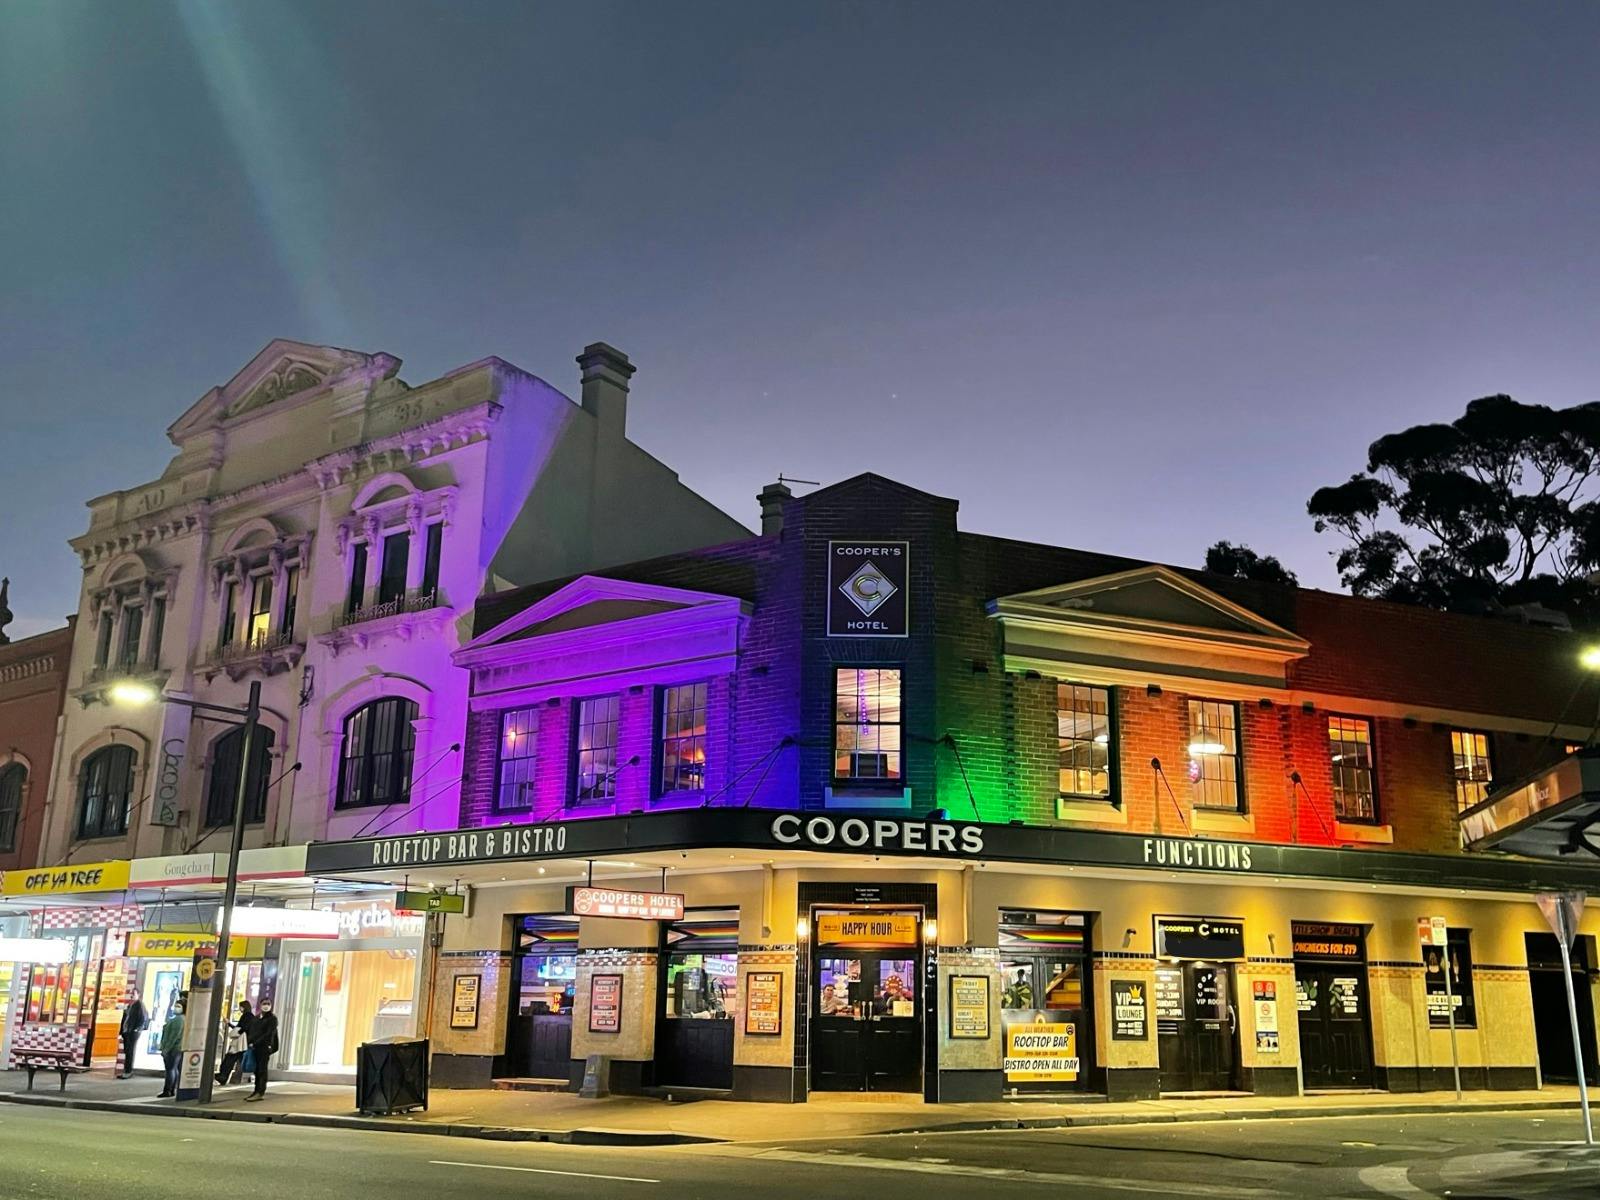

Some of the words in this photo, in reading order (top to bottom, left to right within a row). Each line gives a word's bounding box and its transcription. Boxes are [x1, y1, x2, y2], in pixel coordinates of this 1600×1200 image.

[836, 547, 902, 556] COOPER'S
[851, 574, 882, 602] C
[847, 621, 888, 630] HOTEL
[771, 813, 984, 854] COOPERS
[372, 838, 441, 865] ROOFTOP
[448, 834, 478, 859] BAR
[485, 832, 496, 857] &
[502, 826, 567, 855] BISTRO
[1143, 839, 1252, 870] FUNCTIONS
[164, 862, 187, 877] Gong
[25, 872, 51, 889] OFF
[51, 872, 68, 888] YA
[71, 869, 104, 886] TREE
[429, 899, 441, 907] TAB
[592, 891, 645, 906] COOPERS
[650, 896, 683, 908] HOTEL
[842, 922, 868, 936] HAPPY
[870, 922, 892, 936] HOUR
[1212, 927, 1240, 935] HOTEL
[145, 939, 175, 951] OFF
[177, 939, 196, 951] YA
[1115, 992, 1131, 1006] VIP
[1117, 1009, 1143, 1019] LOUNGE
[1014, 1035, 1052, 1048] ROOFTOP
[1053, 1036, 1069, 1048] BAR
[1004, 1059, 1031, 1070] BISTRO
[1032, 1059, 1051, 1070] OPEN
[1052, 1060, 1063, 1070] ALL
[1063, 1059, 1079, 1070] DAY
